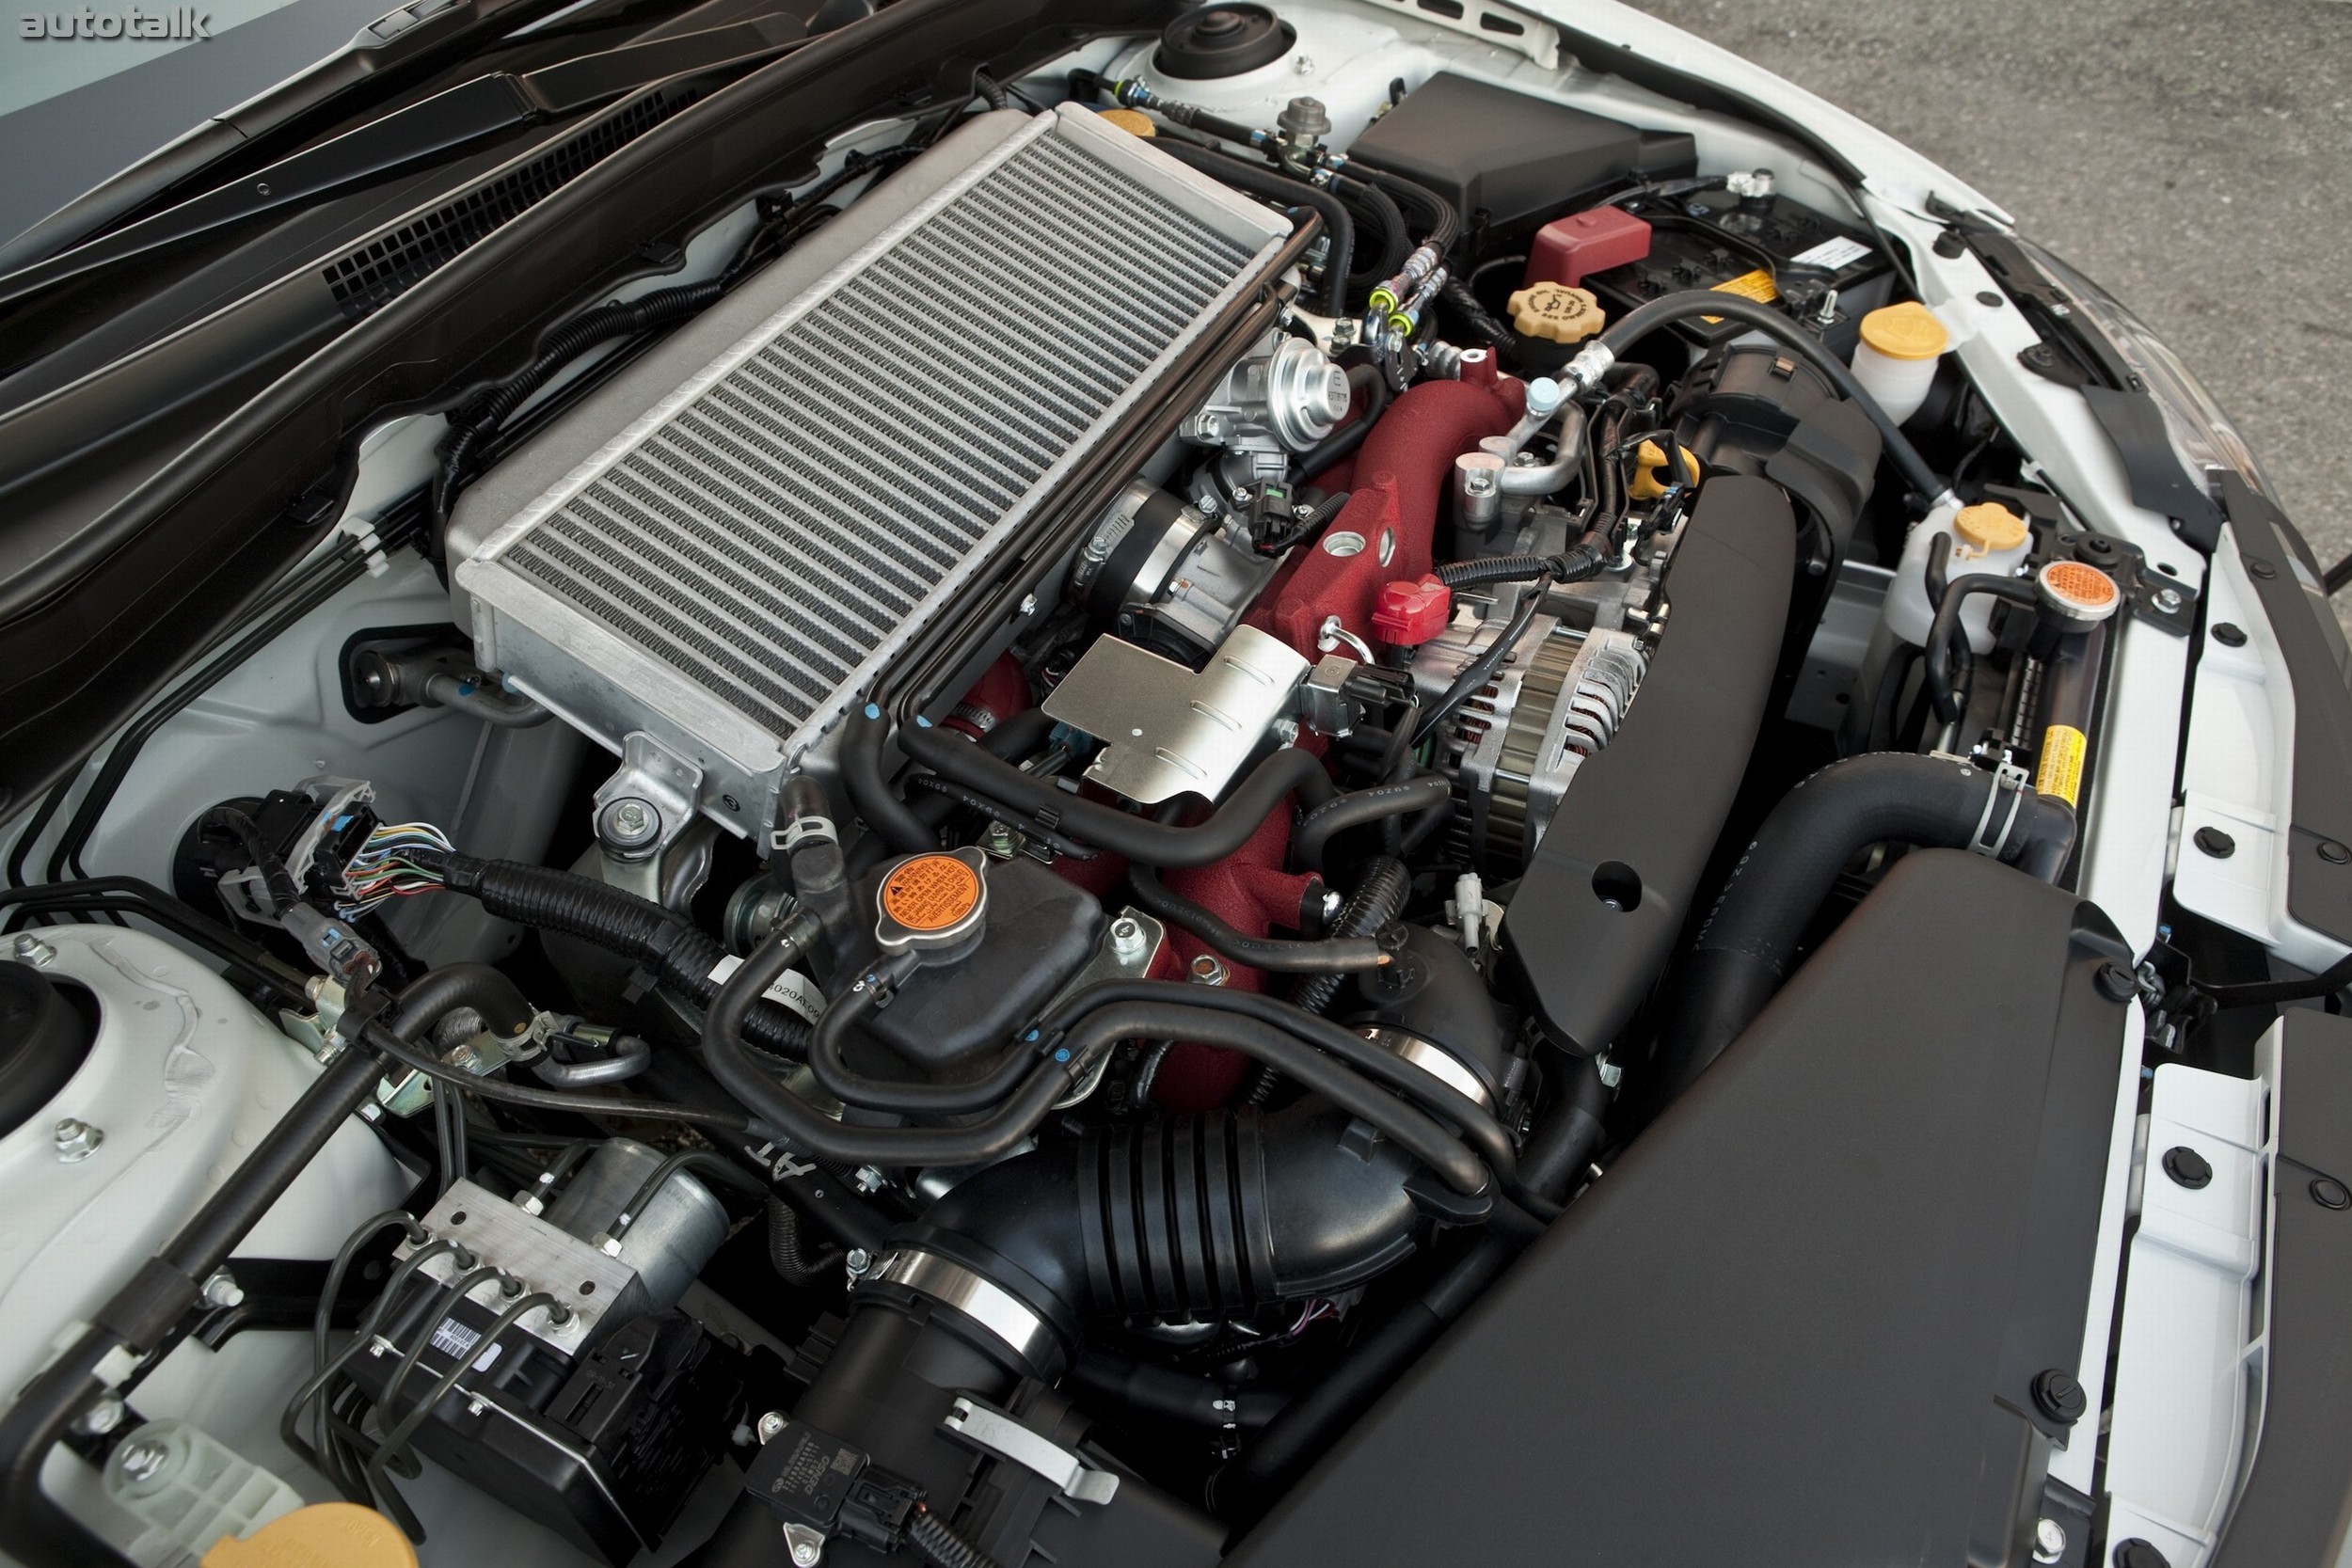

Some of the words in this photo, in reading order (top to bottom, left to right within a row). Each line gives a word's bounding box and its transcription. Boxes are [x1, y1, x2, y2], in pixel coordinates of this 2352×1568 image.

[900, 862, 928, 886] WARNING
[899, 900, 917, 917] NEVER
[915, 888, 930, 902] OPEN
[930, 874, 946, 889] WHEN
[927, 885, 969, 922] AVERTISSEMENT
[803, 1455, 830, 1496] DENSO
